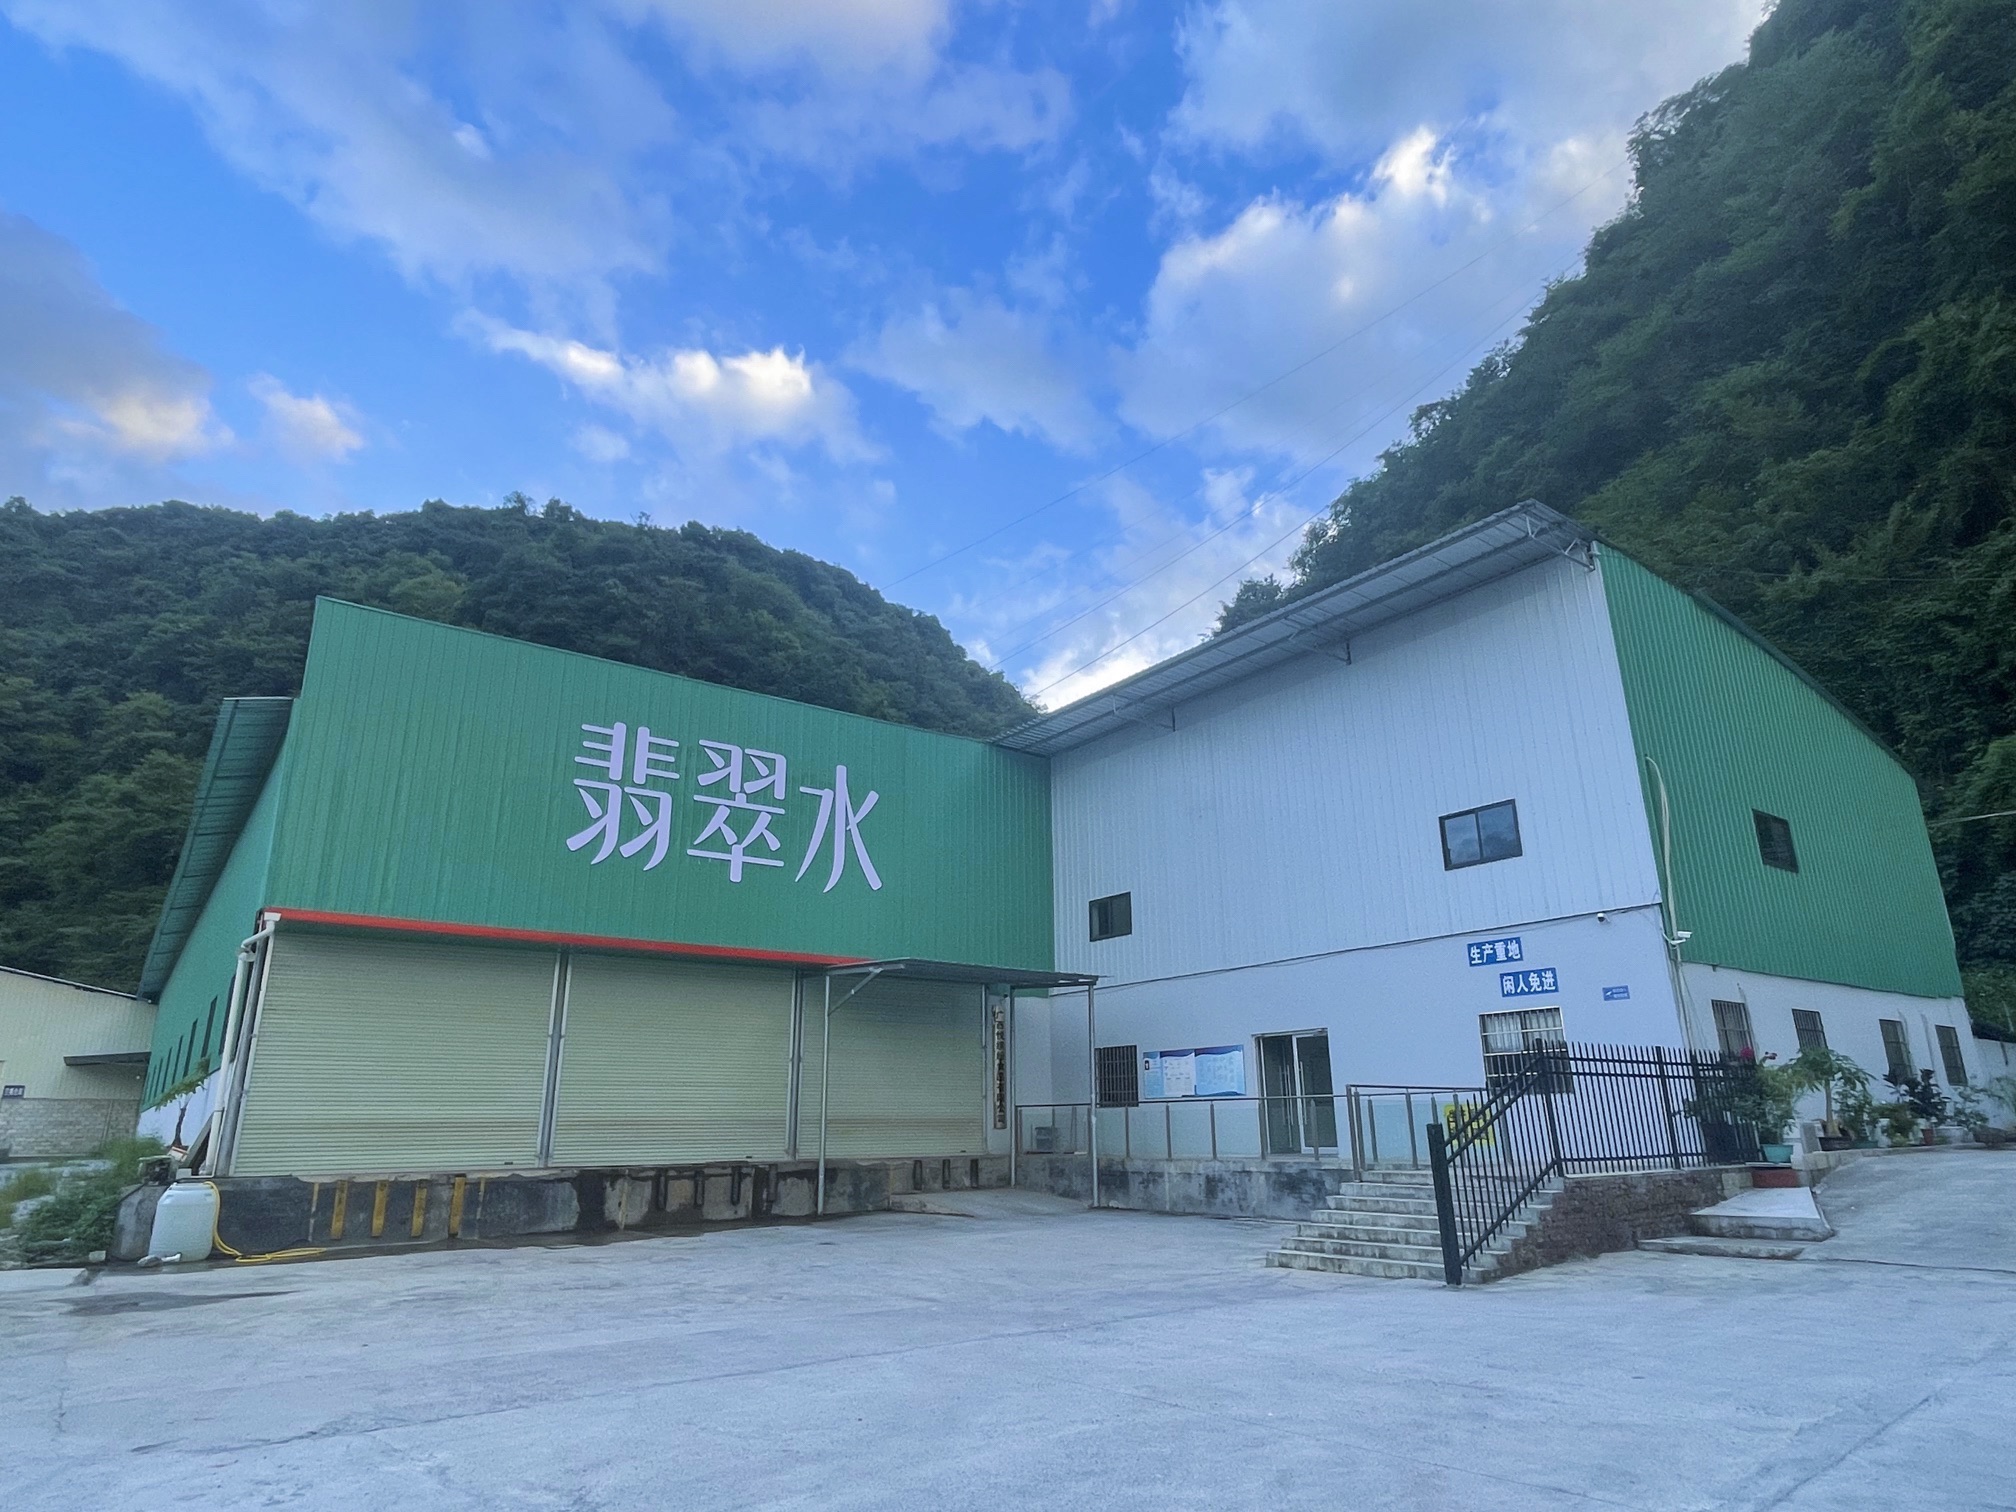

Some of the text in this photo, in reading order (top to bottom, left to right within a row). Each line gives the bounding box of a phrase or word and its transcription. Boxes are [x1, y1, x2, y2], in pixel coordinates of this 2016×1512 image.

[566, 722, 882, 893] 翡翠水
[1470, 940, 1522, 965] 生产重地
[1502, 971, 1556, 995] 闲人免进
